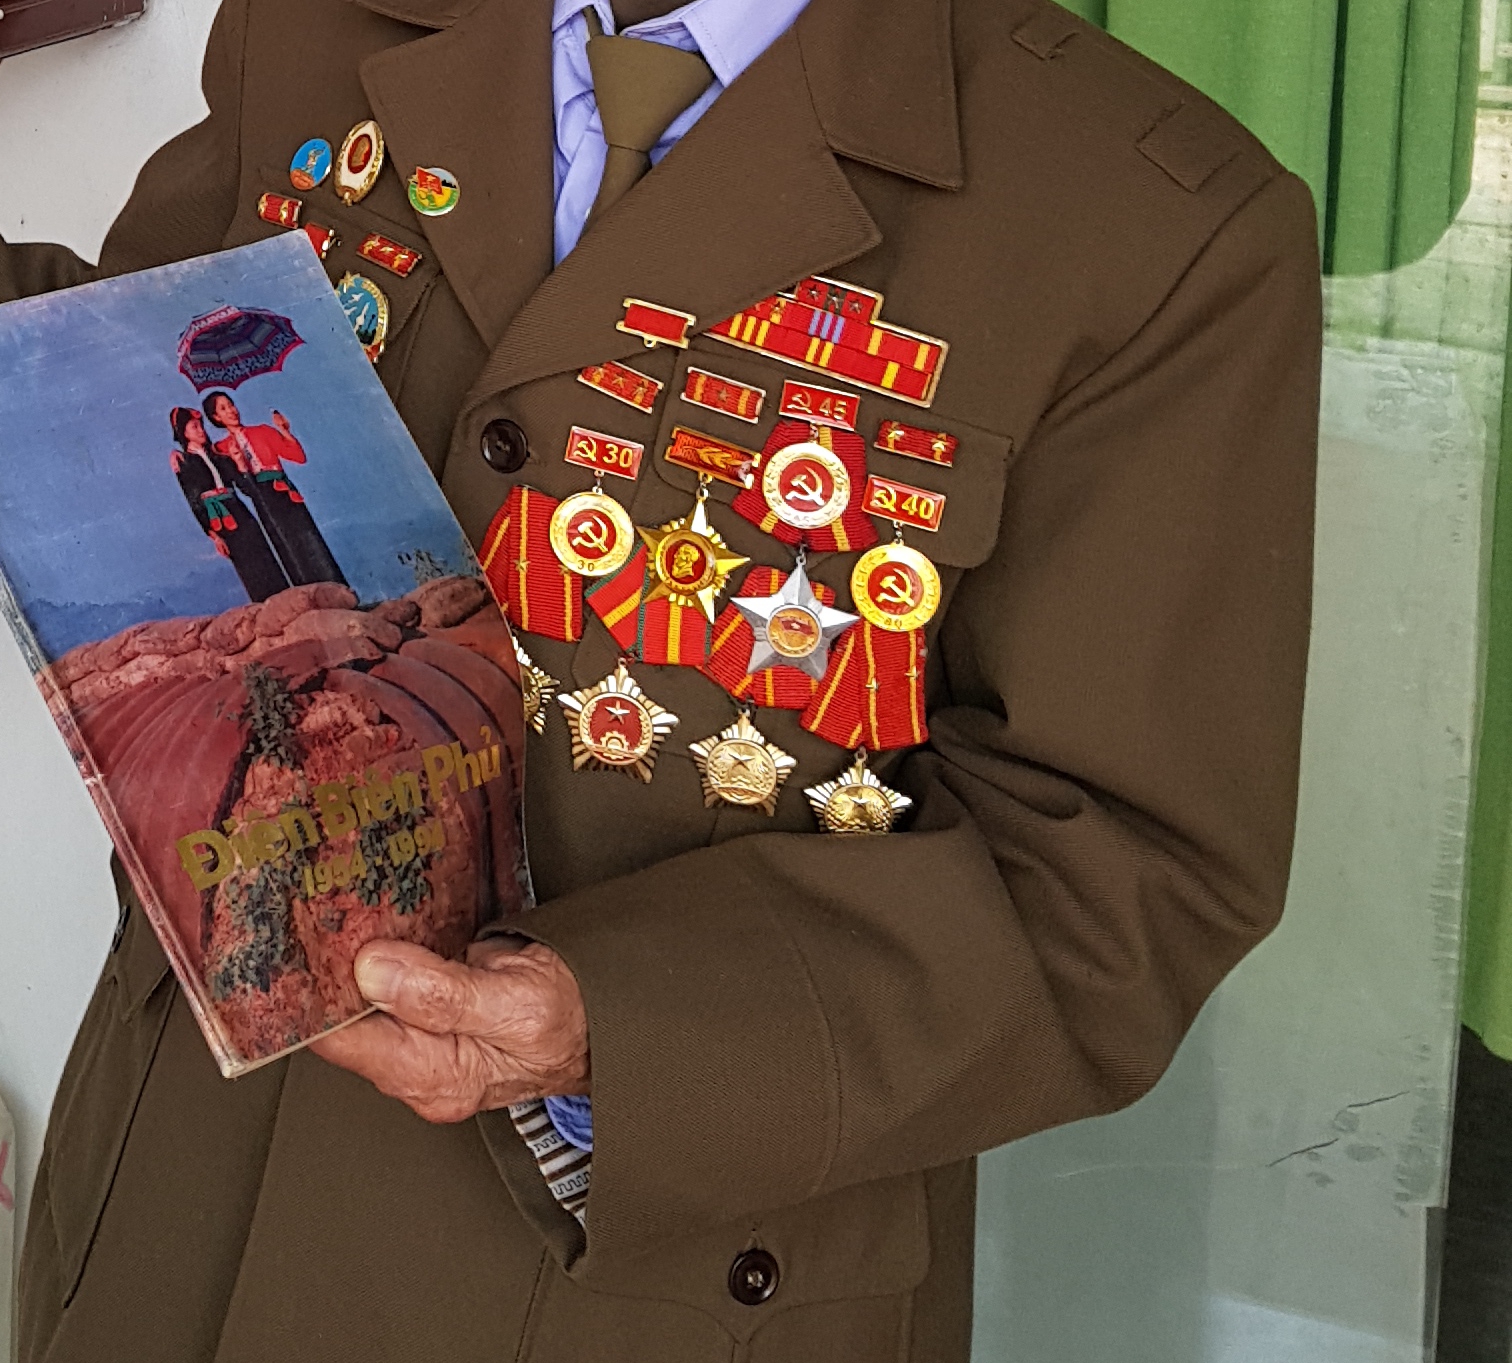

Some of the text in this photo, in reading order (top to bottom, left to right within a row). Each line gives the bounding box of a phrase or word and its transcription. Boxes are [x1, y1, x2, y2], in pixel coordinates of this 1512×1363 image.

[818, 392, 847, 421] 45
[603, 443, 633, 468] 30
[901, 494, 935, 520] 40
[578, 559, 595, 572] 30
[176, 725, 502, 892] Điện Biên Phủ
[302, 847, 368, 898] 1954
